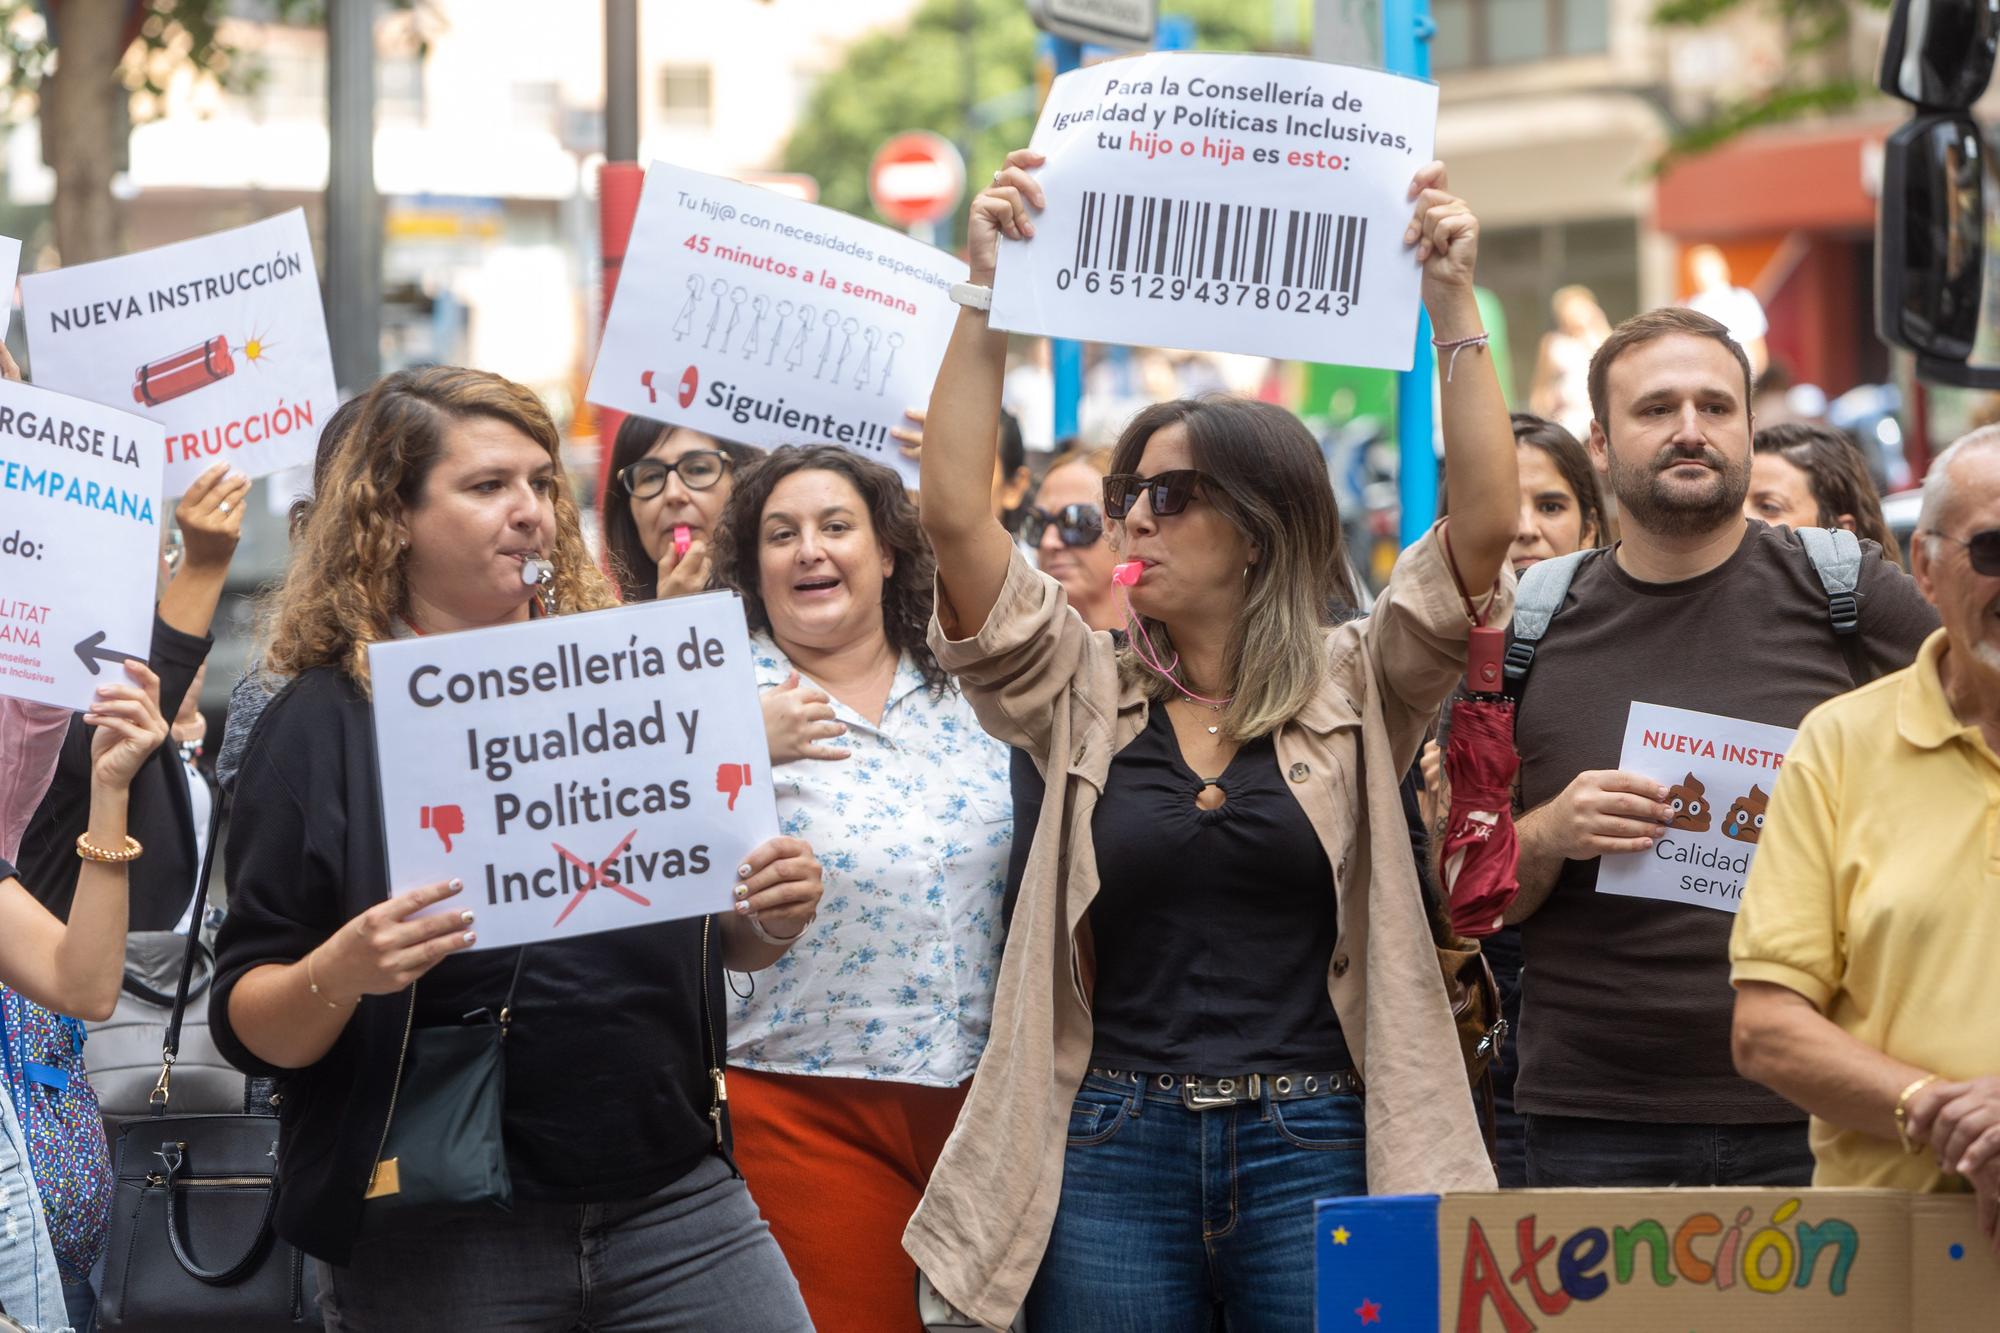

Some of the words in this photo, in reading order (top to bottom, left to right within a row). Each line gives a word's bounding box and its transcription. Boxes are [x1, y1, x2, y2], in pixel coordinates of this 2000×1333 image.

[1104, 79, 1152, 97] Para
[1160, 76, 1179, 96] la
[1187, 77, 1325, 110] Consellería
[1331, 90, 1363, 113] de
[1052, 103, 1147, 130] Igualdad
[1152, 109, 1166, 130] y
[1172, 106, 1278, 134] Políticas
[1285, 115, 1413, 155] Inclusivas,
[1097, 131, 1122, 150] tu
[1128, 131, 1173, 160] hijo
[1180, 142, 1195, 157] o
[1202, 137, 1246, 166] hija
[1252, 147, 1280, 164] es
[1287, 151, 1350, 172] esto:
[677, 191, 696, 210] Tu
[701, 198, 737, 222] hij@
[740, 211, 771, 231] con
[773, 222, 873, 262] necesidades
[50, 296, 142, 333] NUEVA
[149, 251, 302, 314] INSTRUCCIÓN
[683, 233, 711, 256] 45
[713, 241, 798, 280] minutos
[802, 267, 815, 283] a
[819, 269, 837, 291] la
[841, 282, 918, 317] semana
[706, 380, 887, 451] Siguiente!!!
[112, 435, 140, 468] LA
[0, 459, 154, 525] EMPARANA
[0, 529, 44, 561] do:
[0, 598, 51, 625] LITAT
[408, 634, 665, 708] Consellería
[676, 626, 725, 671] de
[467, 700, 666, 782] Igualdad
[676, 709, 699, 755] y
[1642, 729, 1716, 759] NUEVA
[1722, 743, 1785, 770] INSTR
[494, 778, 692, 835] Políticas
[485, 844, 711, 905] Inclusivas
[1655, 839, 1749, 875] Calidad
[1455, 1198, 1859, 1333] Atención
